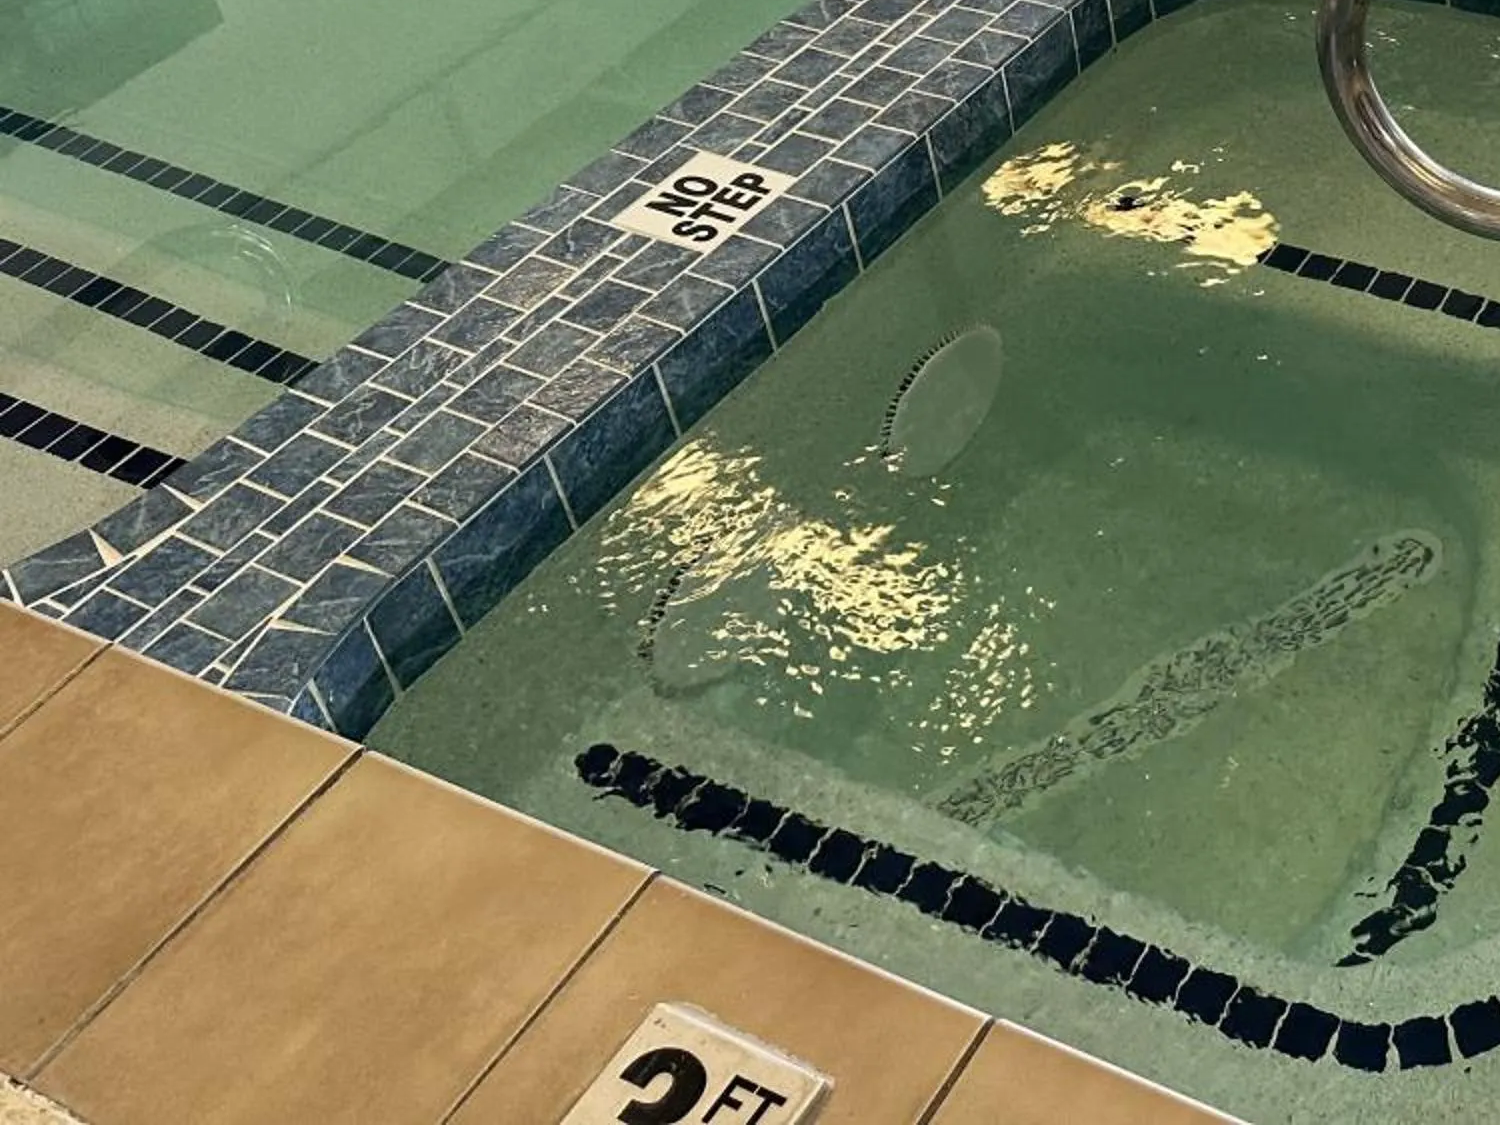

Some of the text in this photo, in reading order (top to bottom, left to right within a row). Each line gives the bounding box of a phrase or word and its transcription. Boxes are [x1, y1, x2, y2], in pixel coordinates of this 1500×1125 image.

[643, 175, 718, 217] NO
[671, 172, 771, 242] STEP
[702, 1074, 788, 1125] FT
